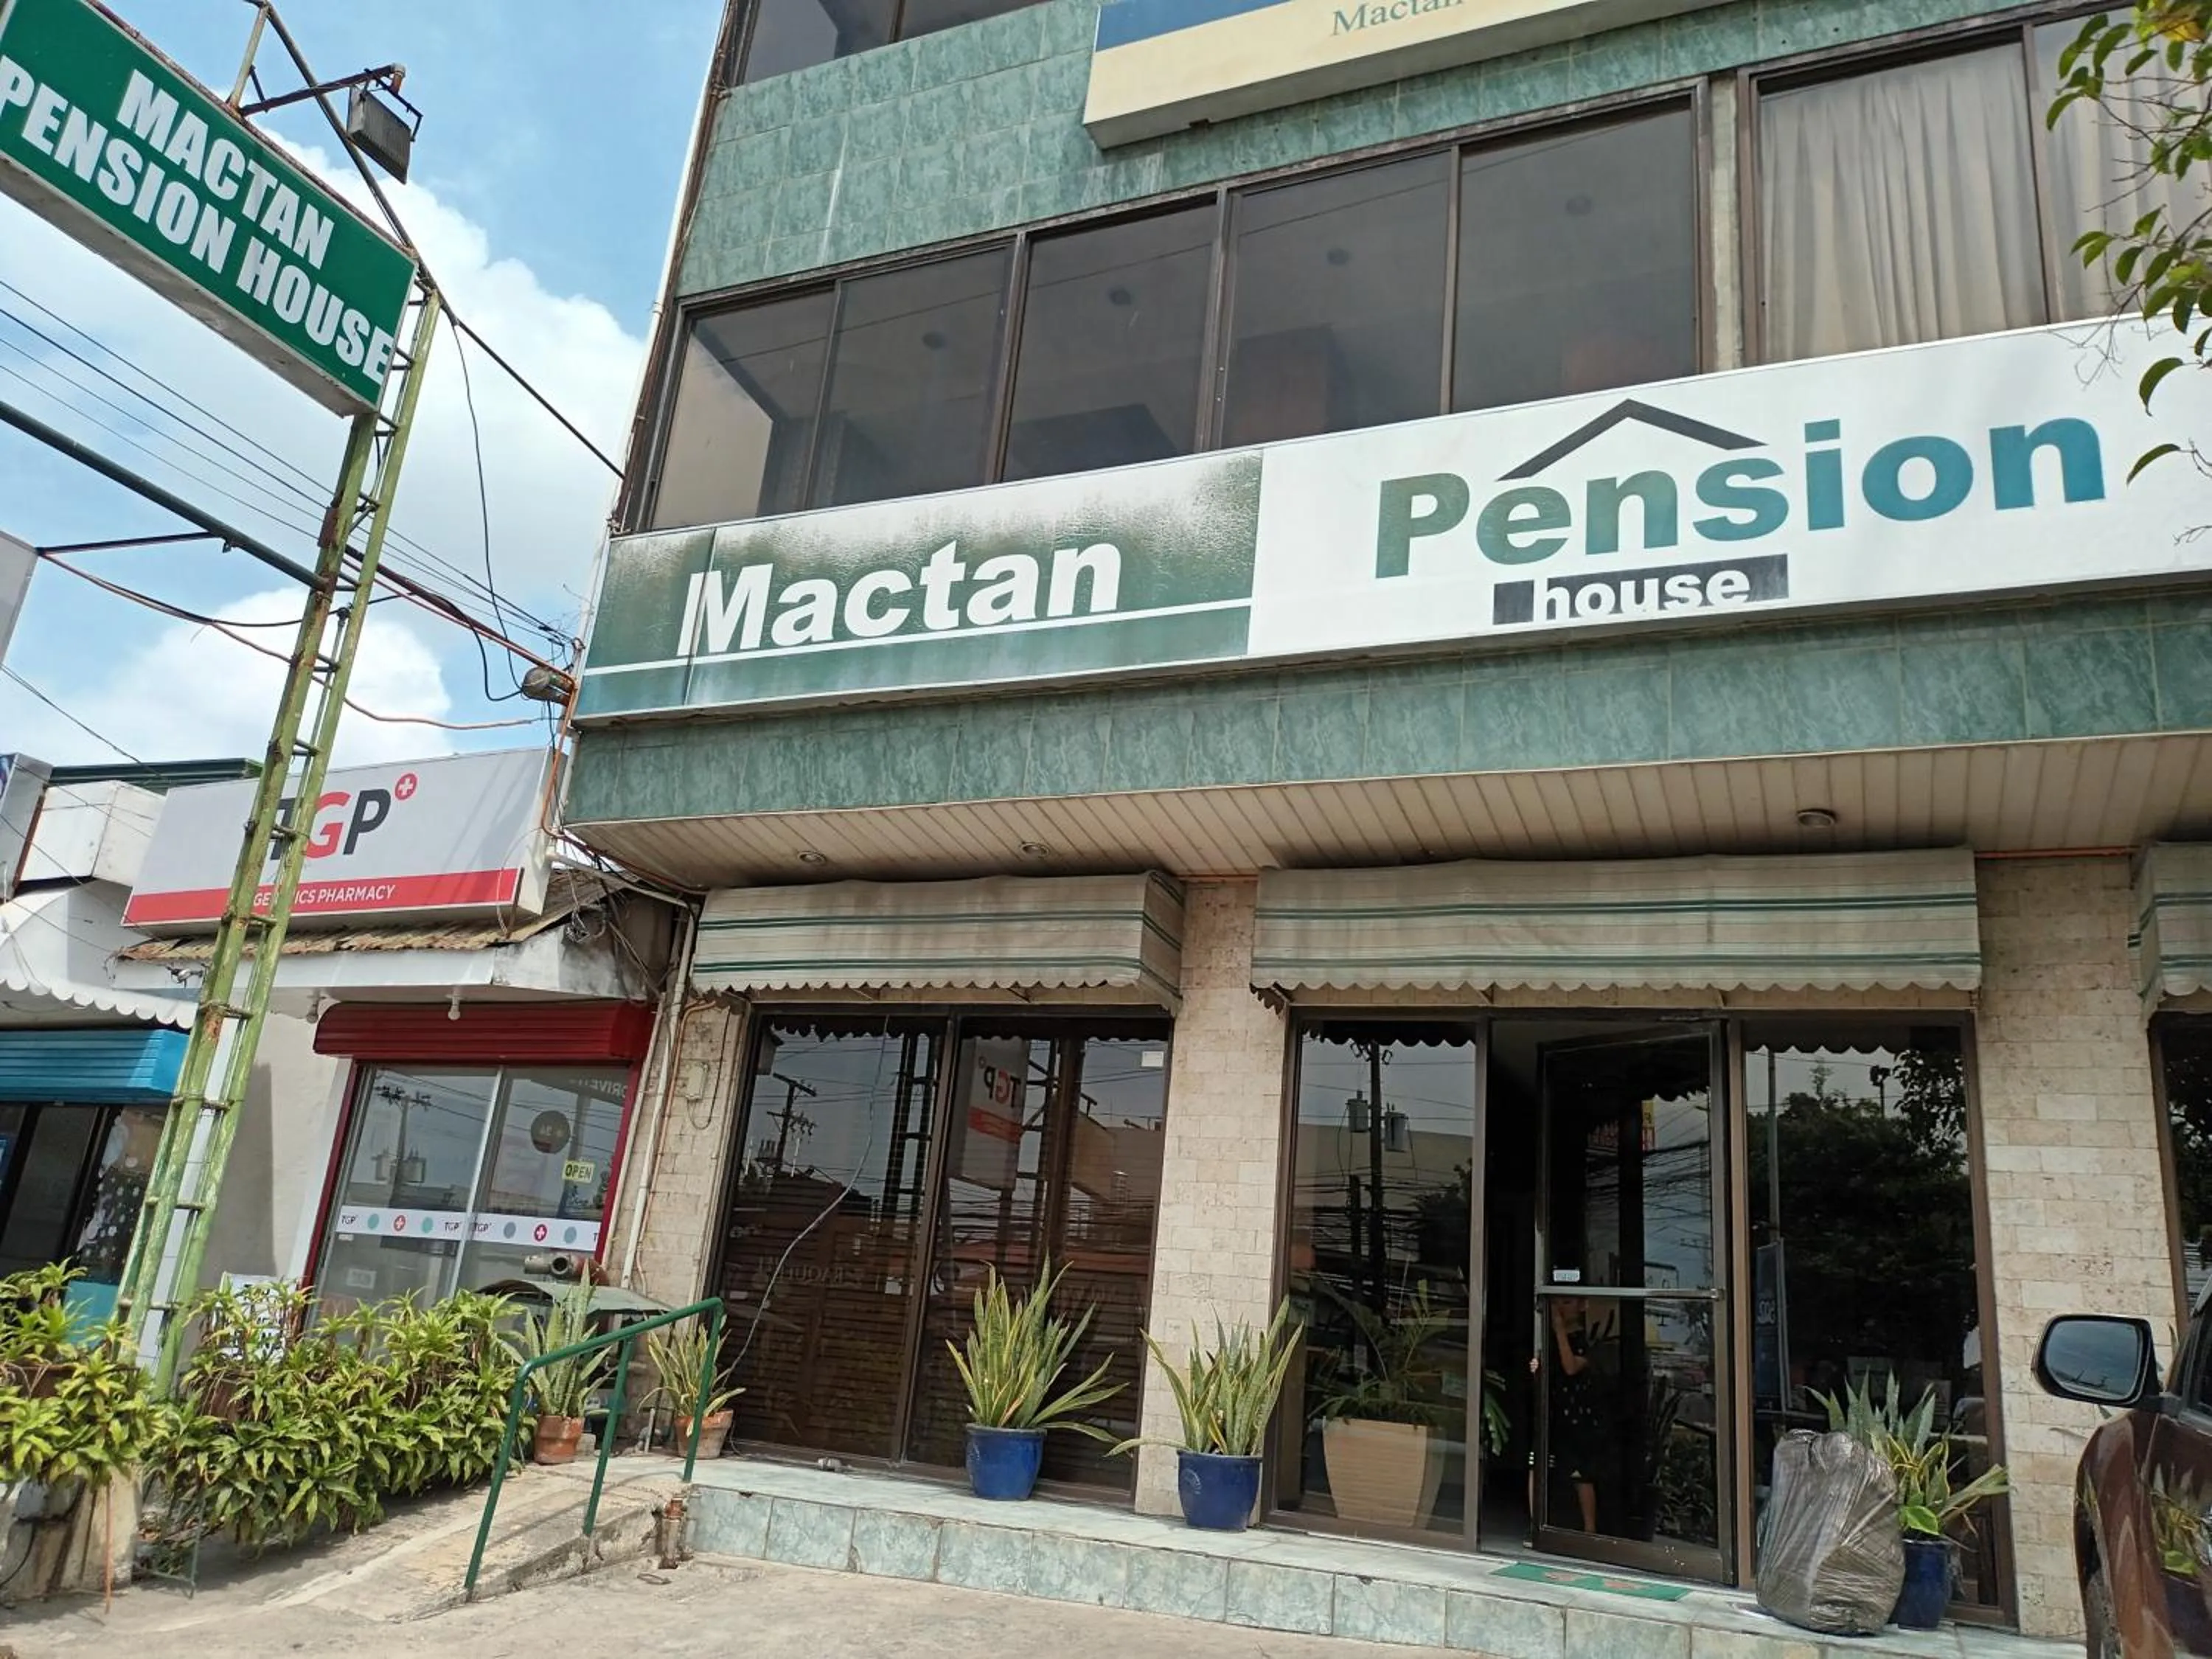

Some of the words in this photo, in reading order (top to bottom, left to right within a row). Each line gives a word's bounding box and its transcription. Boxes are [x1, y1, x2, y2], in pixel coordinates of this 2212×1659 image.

[0, 55, 237, 274] PENSION
[235, 235, 395, 385] HOUSE
[116, 69, 335, 270] MACTAN
[1375, 417, 2106, 579] Pension
[675, 540, 1121, 657] Mactan
[1534, 568, 1750, 622] house
[254, 887, 316, 907] GEICS
[317, 885, 395, 904] PHARMACY
[566, 1164, 592, 1179] OPEN
